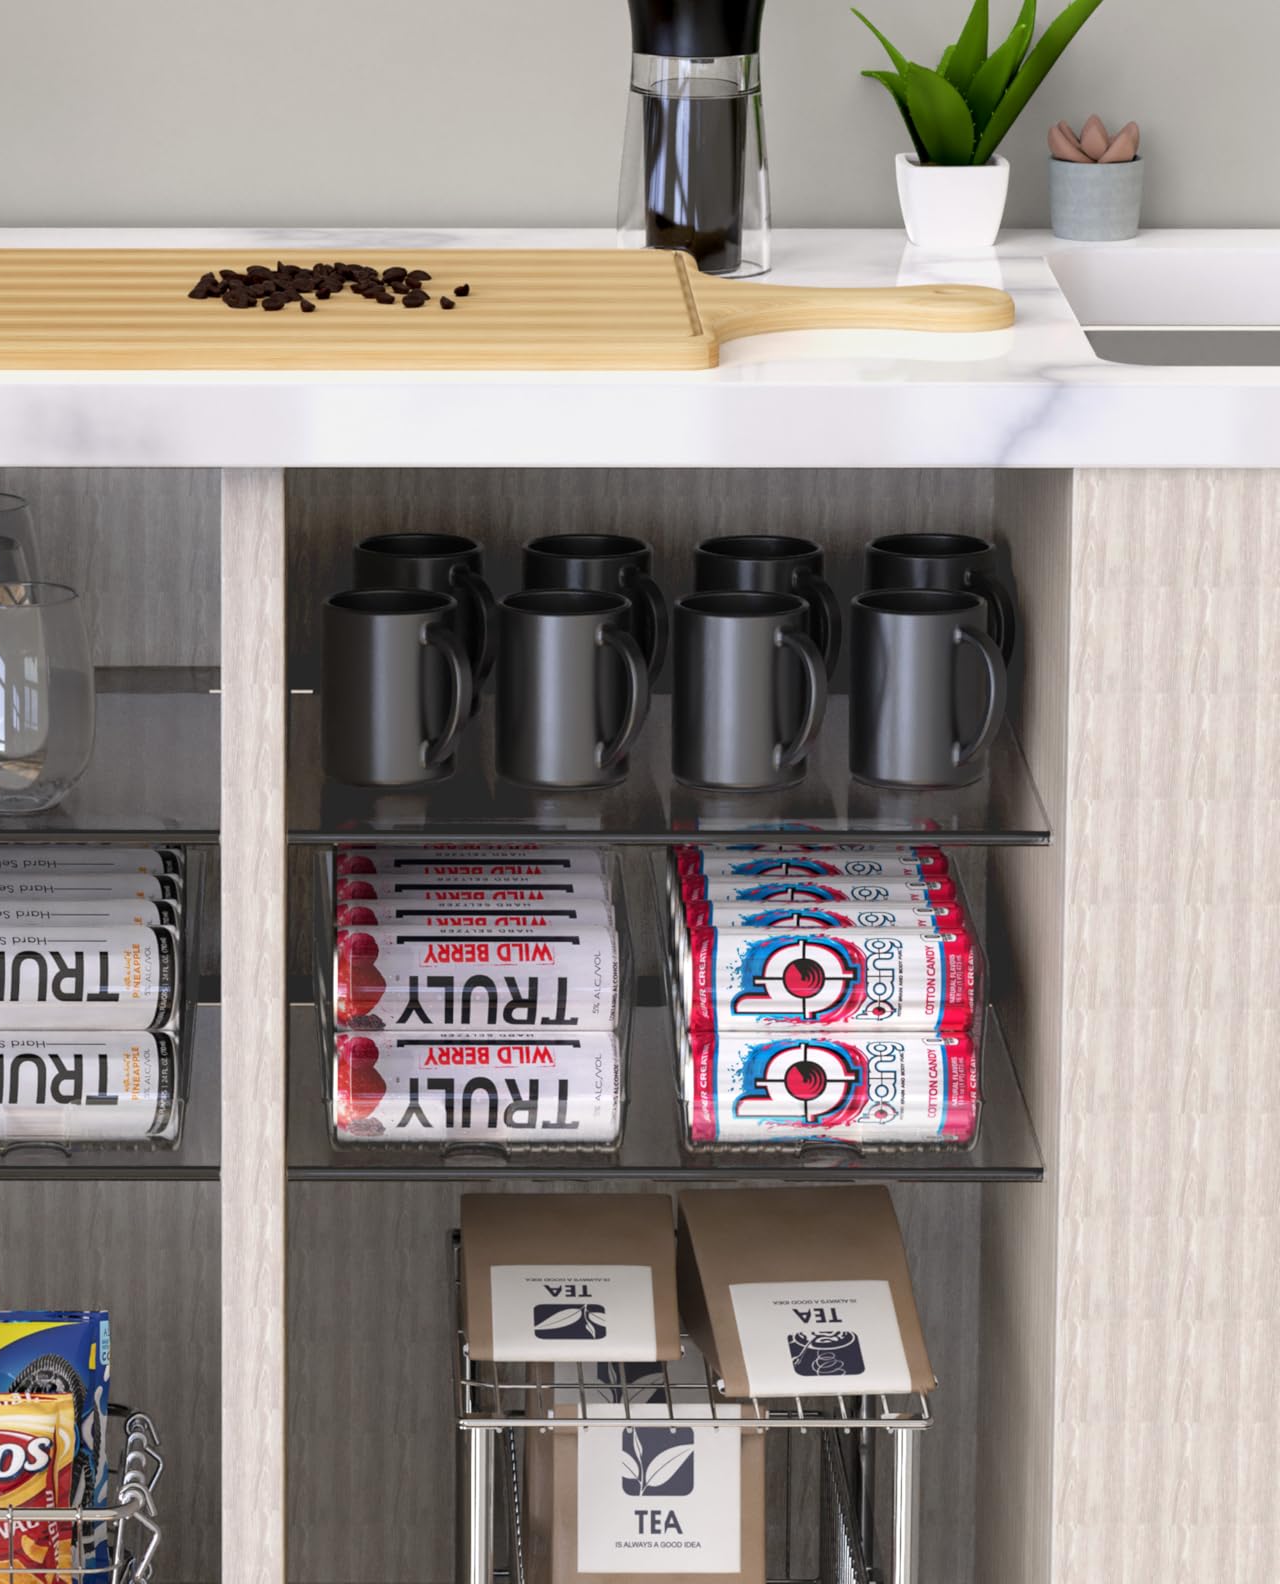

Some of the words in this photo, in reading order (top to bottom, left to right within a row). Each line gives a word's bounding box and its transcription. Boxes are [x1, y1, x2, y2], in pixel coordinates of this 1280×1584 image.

[23, 859, 57, 869] Hard
[19, 884, 55, 894] Hard
[15, 909, 50, 919] Hard
[11, 936, 47, 945] Hard
[424, 943, 489, 963] BERRY
[497, 943, 554, 962] WILD
[925, 945, 936, 978] CANDY
[132, 944, 140, 998] PINEAPPLE
[856, 938, 903, 1021] bang
[396, 974, 579, 1025] TRULY
[925, 979, 936, 1015] COTTON
[10, 1039, 46, 1049] Hard
[424, 1047, 490, 1066] BERRY
[497, 1046, 554, 1065] WILD
[927, 1048, 938, 1079] CANDY
[131, 1046, 140, 1100] PINEAPPLE
[857, 1041, 905, 1124] bang
[397, 1076, 580, 1129] TRULY
[928, 1081, 938, 1119] COTTON
[544, 1284, 592, 1298] TEA
[792, 1308, 843, 1324] TEA
[634, 1510, 683, 1535] TEA
